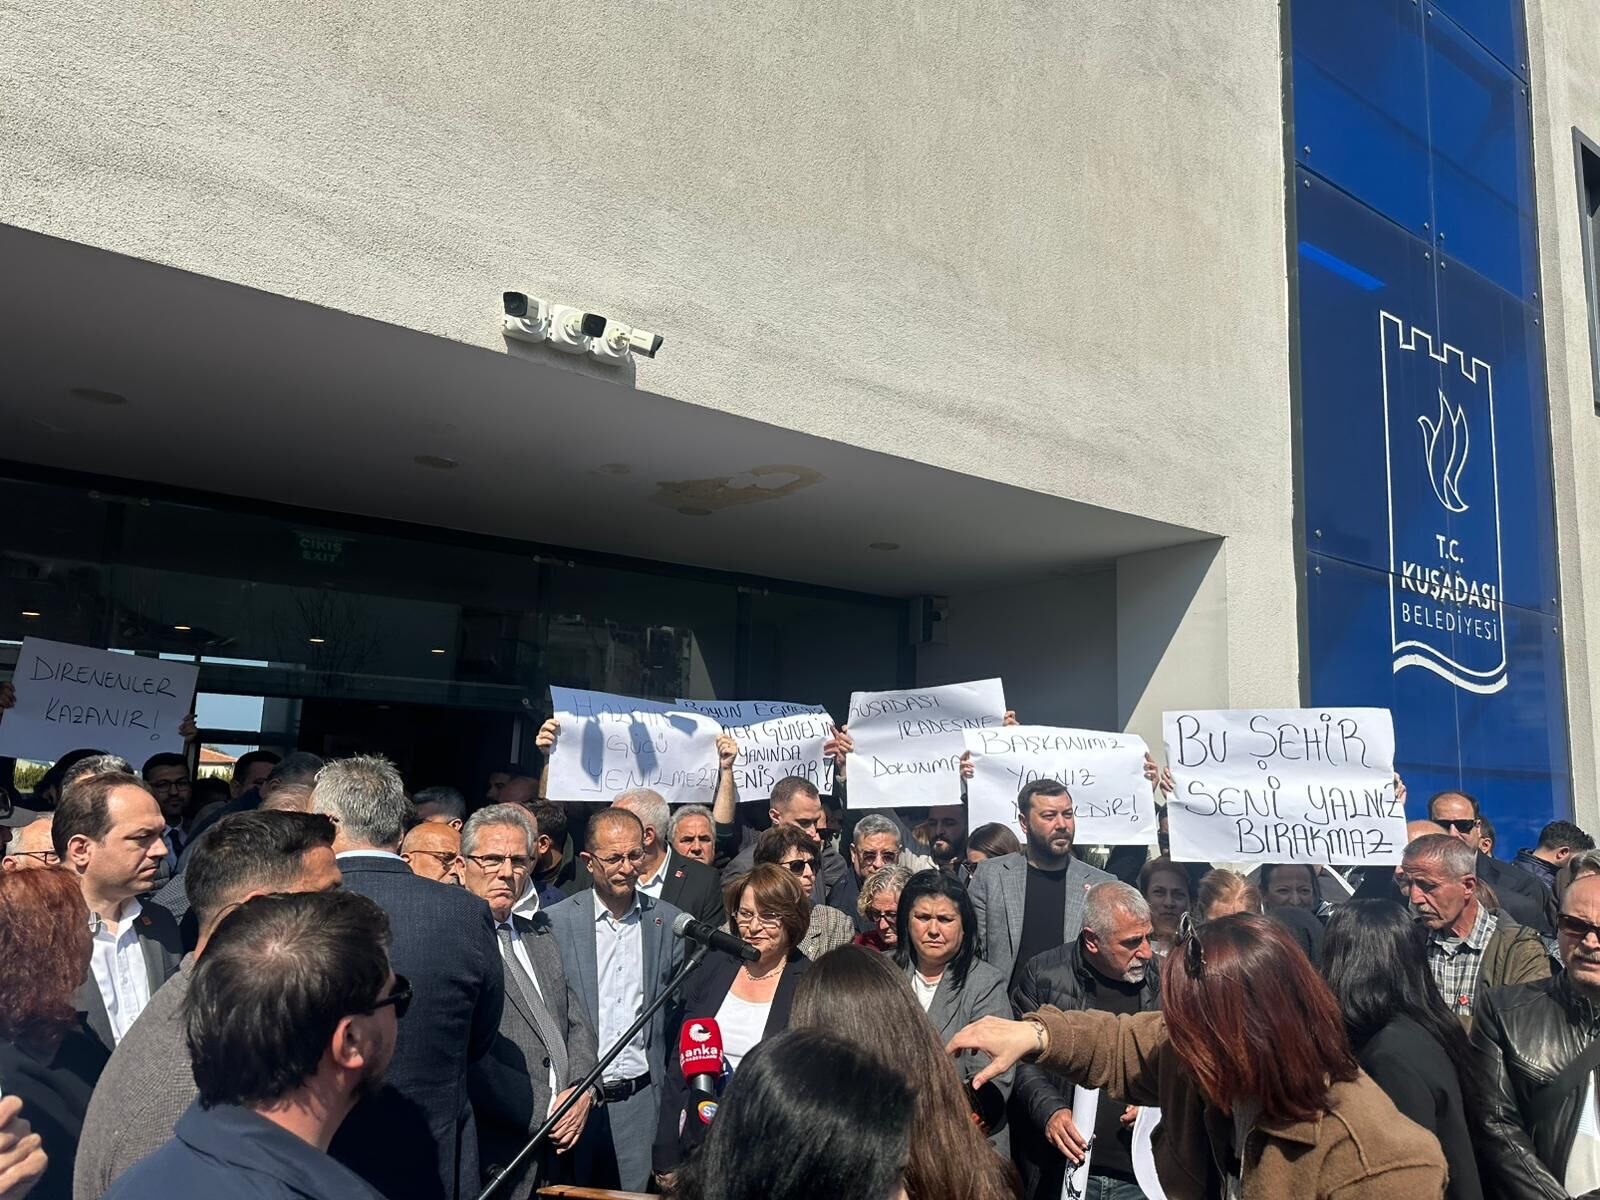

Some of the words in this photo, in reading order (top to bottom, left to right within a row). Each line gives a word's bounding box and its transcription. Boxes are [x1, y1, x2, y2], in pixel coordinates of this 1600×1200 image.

[1436, 534, 1464, 563] T.C.
[1402, 561, 1496, 612] KUŞADASI
[1402, 603, 1497, 641] BELEDİYESİ
[45, 697, 161, 741] KAZANIR!
[734, 744, 801, 767] YANINDA
[1177, 715, 1226, 767] BU
[1250, 713, 1371, 770] ŞEHİR
[1185, 775, 1284, 819] SENİ
[1304, 783, 1403, 825] YALNIZ
[1236, 818, 1392, 863] BIRAKMAZ
[685, 1044, 717, 1057] anka
